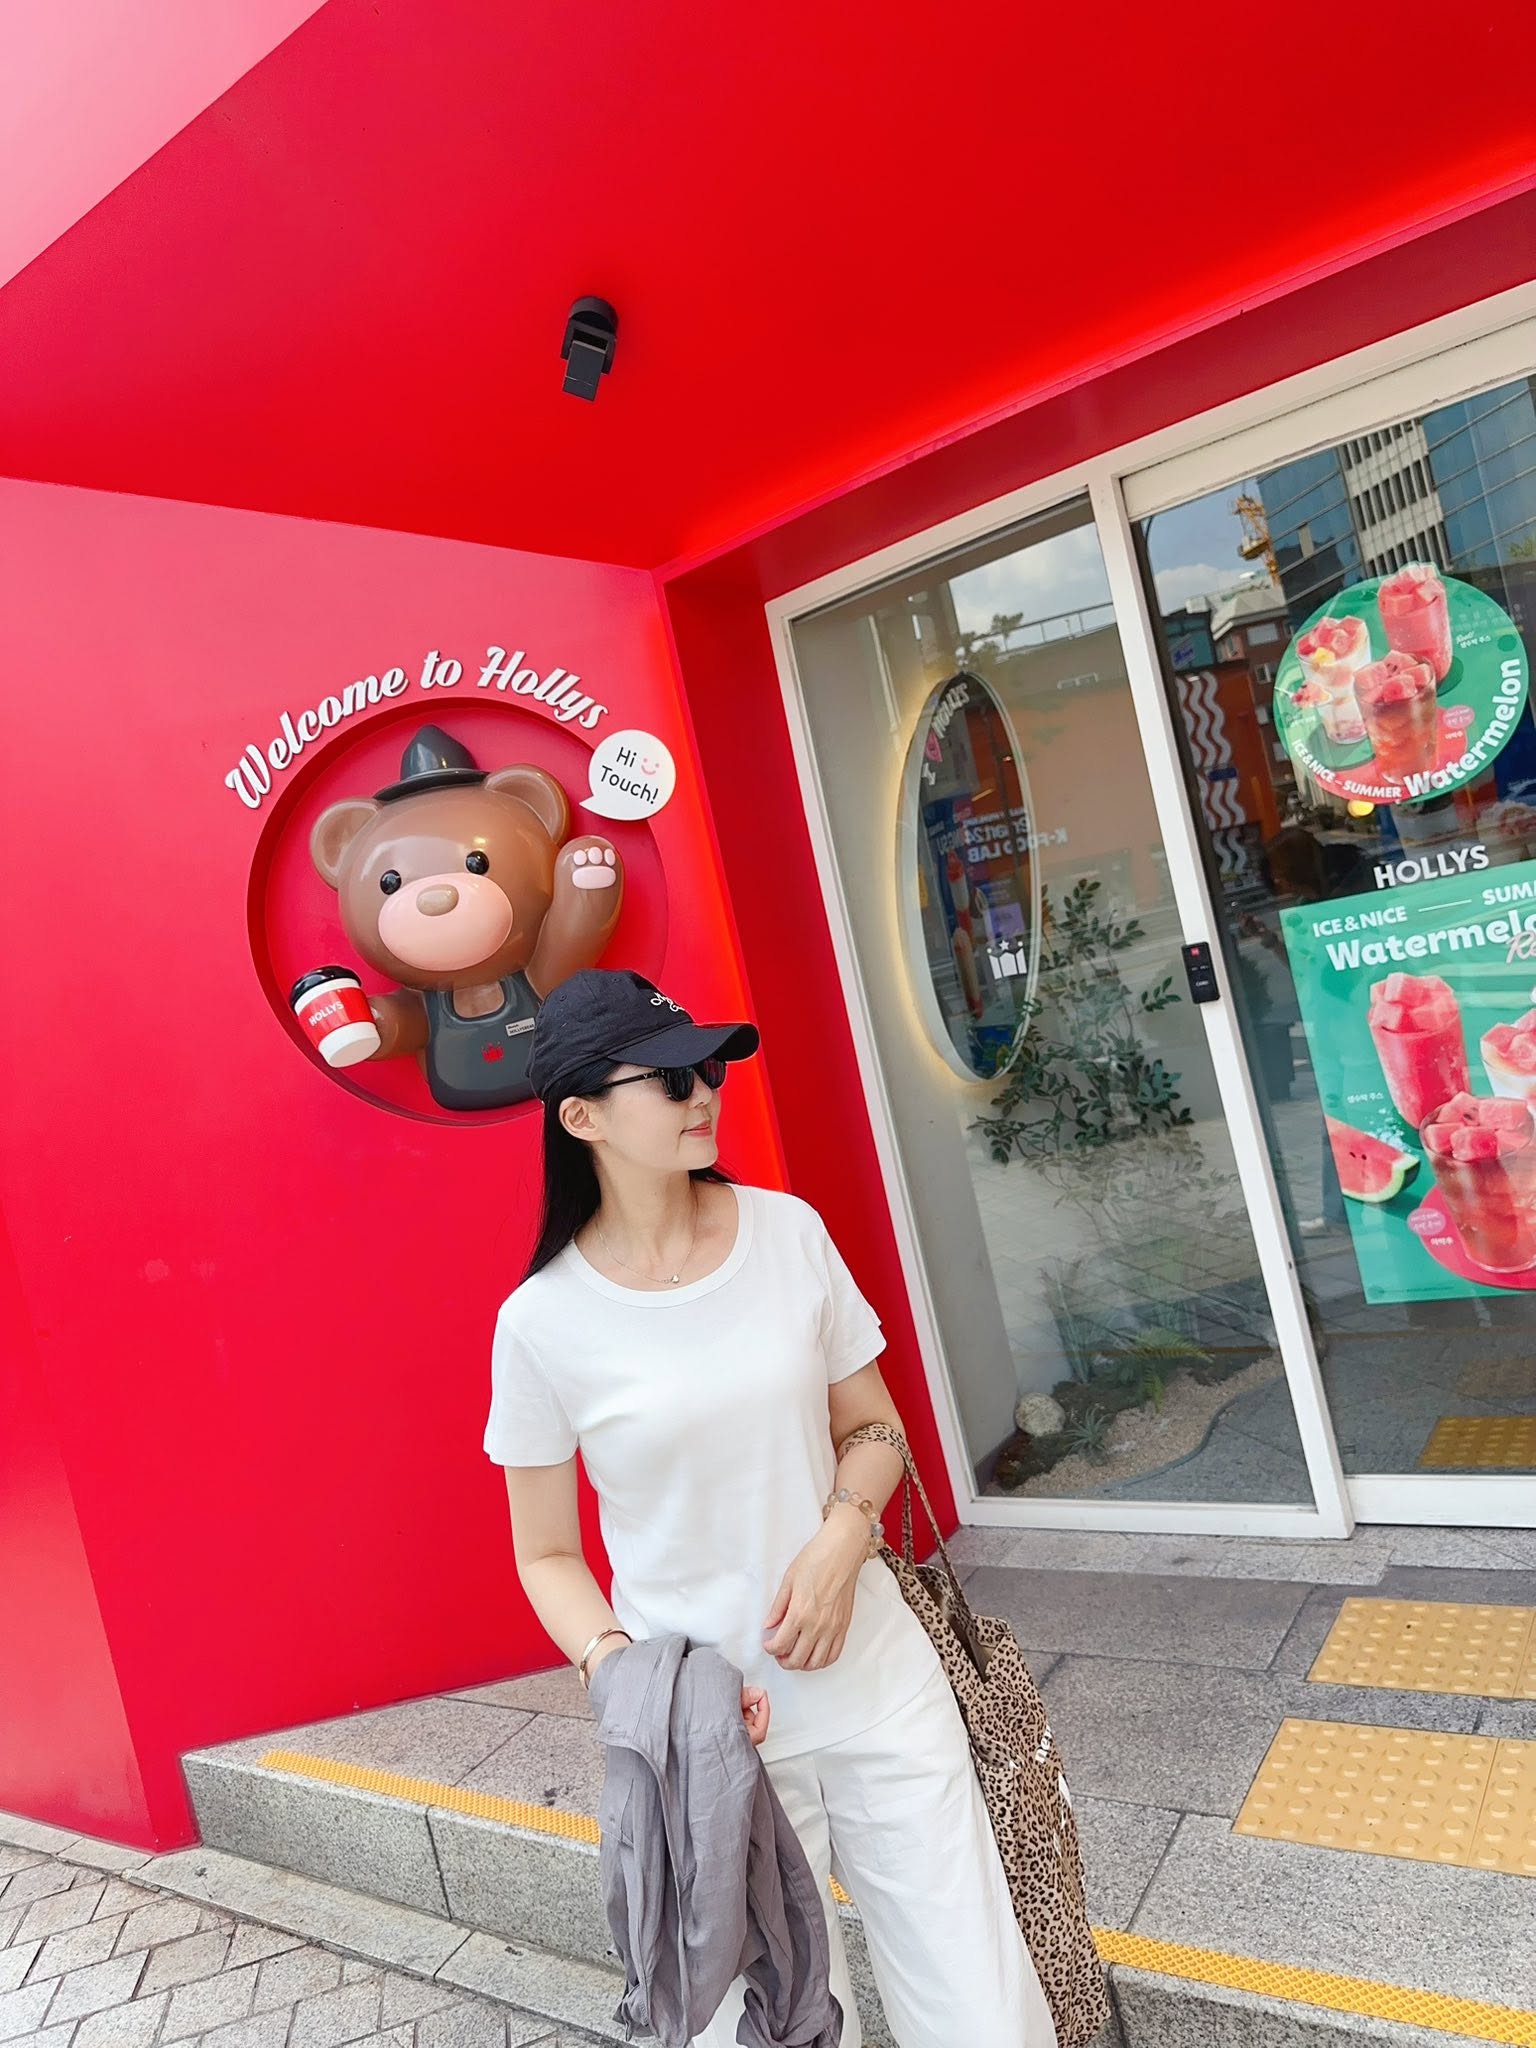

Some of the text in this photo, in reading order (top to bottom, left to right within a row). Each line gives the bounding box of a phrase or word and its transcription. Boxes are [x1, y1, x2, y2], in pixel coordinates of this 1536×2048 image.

[224, 646, 609, 809] Welcome to Hollys
[1291, 739, 1336, 783] ICE&NICE
[1343, 780, 1402, 798] SUMMER
[1403, 658, 1521, 798] Watermelon
[616, 747, 638, 768] Hi
[600, 764, 660, 805] Touch!
[1373, 845, 1489, 889] HOLLYS
[1312, 880, 1536, 938] ICE&NICE SUM
[308, 1000, 345, 1027] HOLLYS
